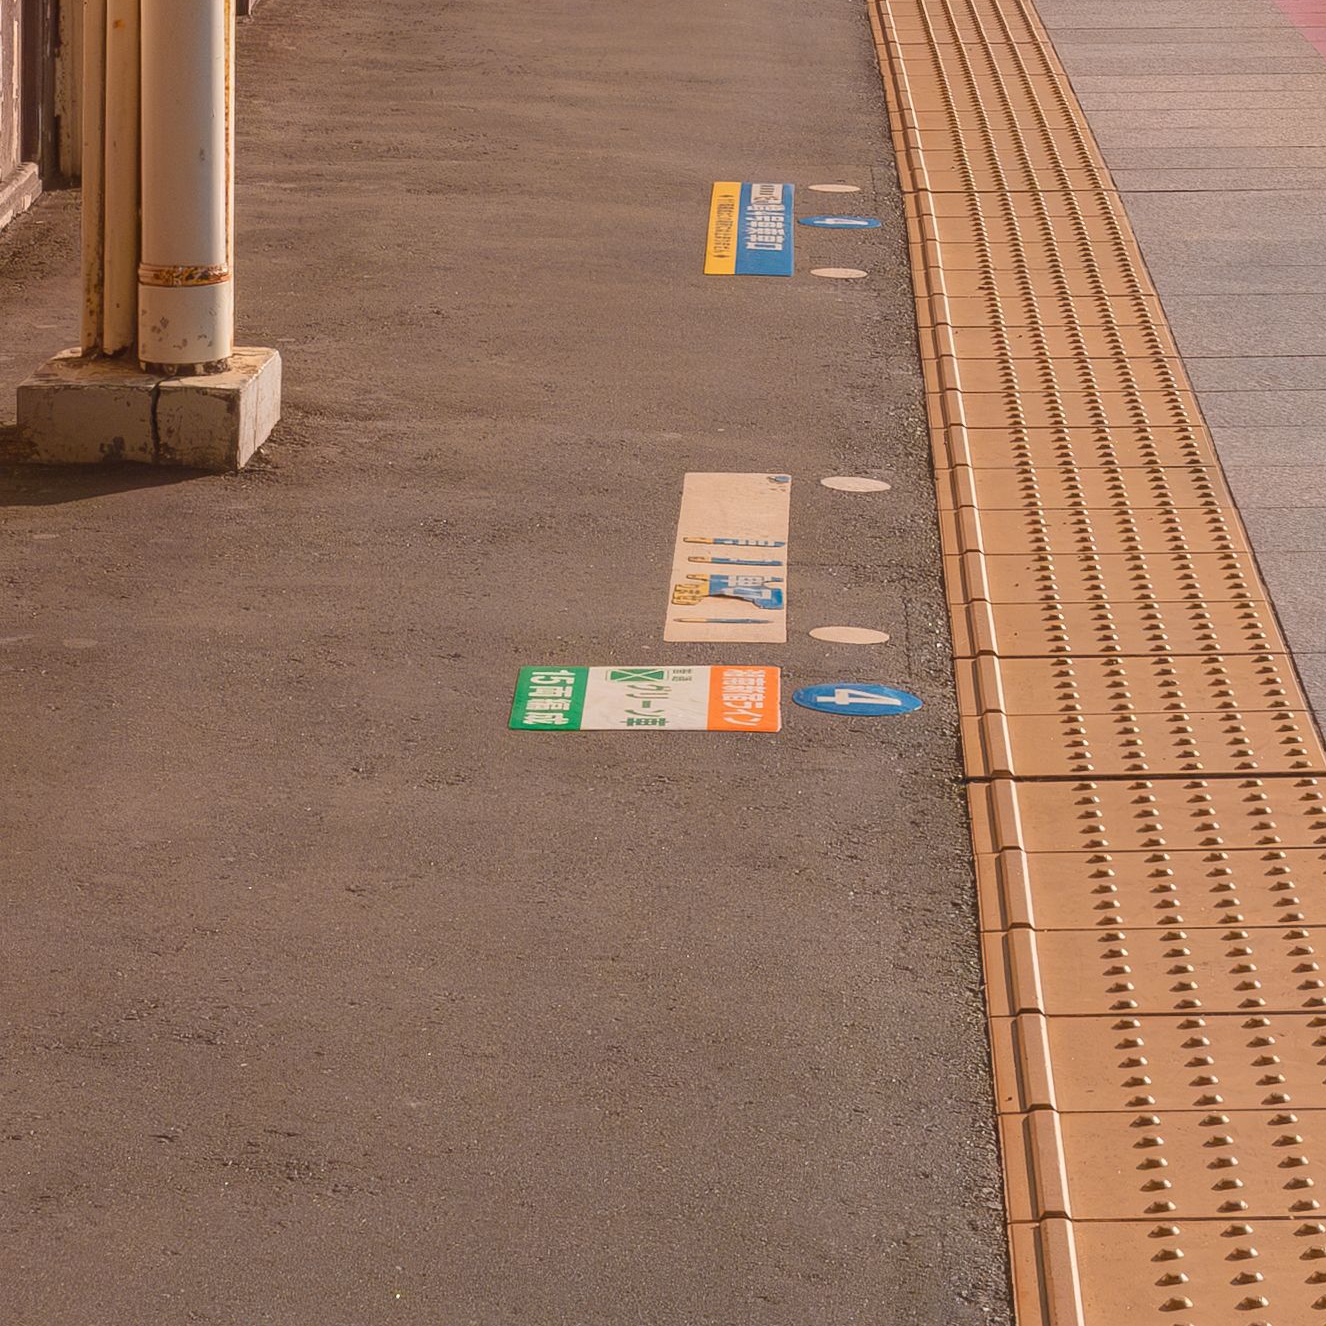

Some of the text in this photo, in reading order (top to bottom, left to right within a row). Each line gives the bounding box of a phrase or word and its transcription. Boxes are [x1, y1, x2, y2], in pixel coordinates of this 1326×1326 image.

[523, 668, 577, 725] 15両編成
[619, 683, 673, 728] グリーン車
[815, 688, 903, 707] 4
